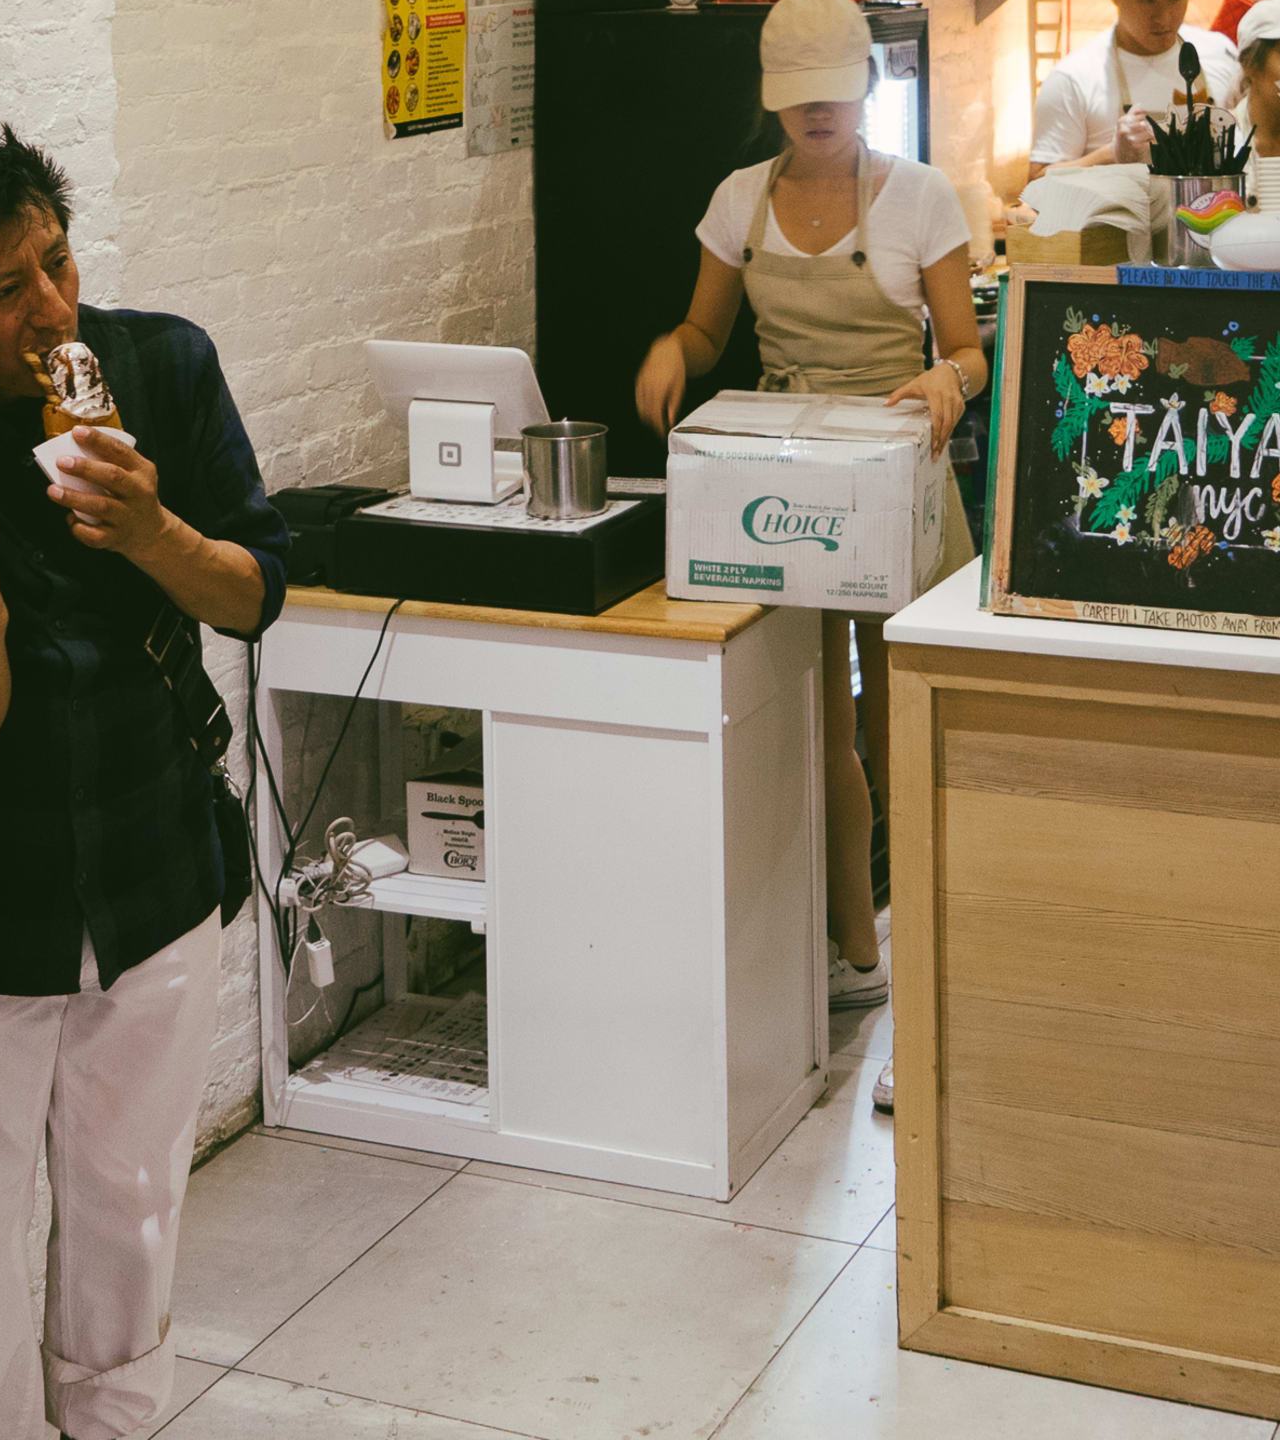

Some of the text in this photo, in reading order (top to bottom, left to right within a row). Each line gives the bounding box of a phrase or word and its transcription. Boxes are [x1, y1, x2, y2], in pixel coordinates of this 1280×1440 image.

[1120, 269, 1160, 285] PLEASE
[1180, 272, 1201, 286] NOT
[1205, 274, 1239, 287] TOUCH
[1247, 274, 1265, 288] THE
[1193, 483, 1266, 540] nyc
[741, 495, 846, 552] CHOICE
[694, 562, 747, 575] WHITE 2 PLY
[694, 572, 782, 587] BEVERAGE NAPKINS
[859, 581, 888, 590] COUNT
[853, 589, 889, 599] NAPKINS
[1143, 609, 1170, 626] TAKE
[1177, 611, 1217, 630] PHOTOS
[1222, 617, 1248, 632] AWAY
[426, 792, 483, 808] Black Spoo
